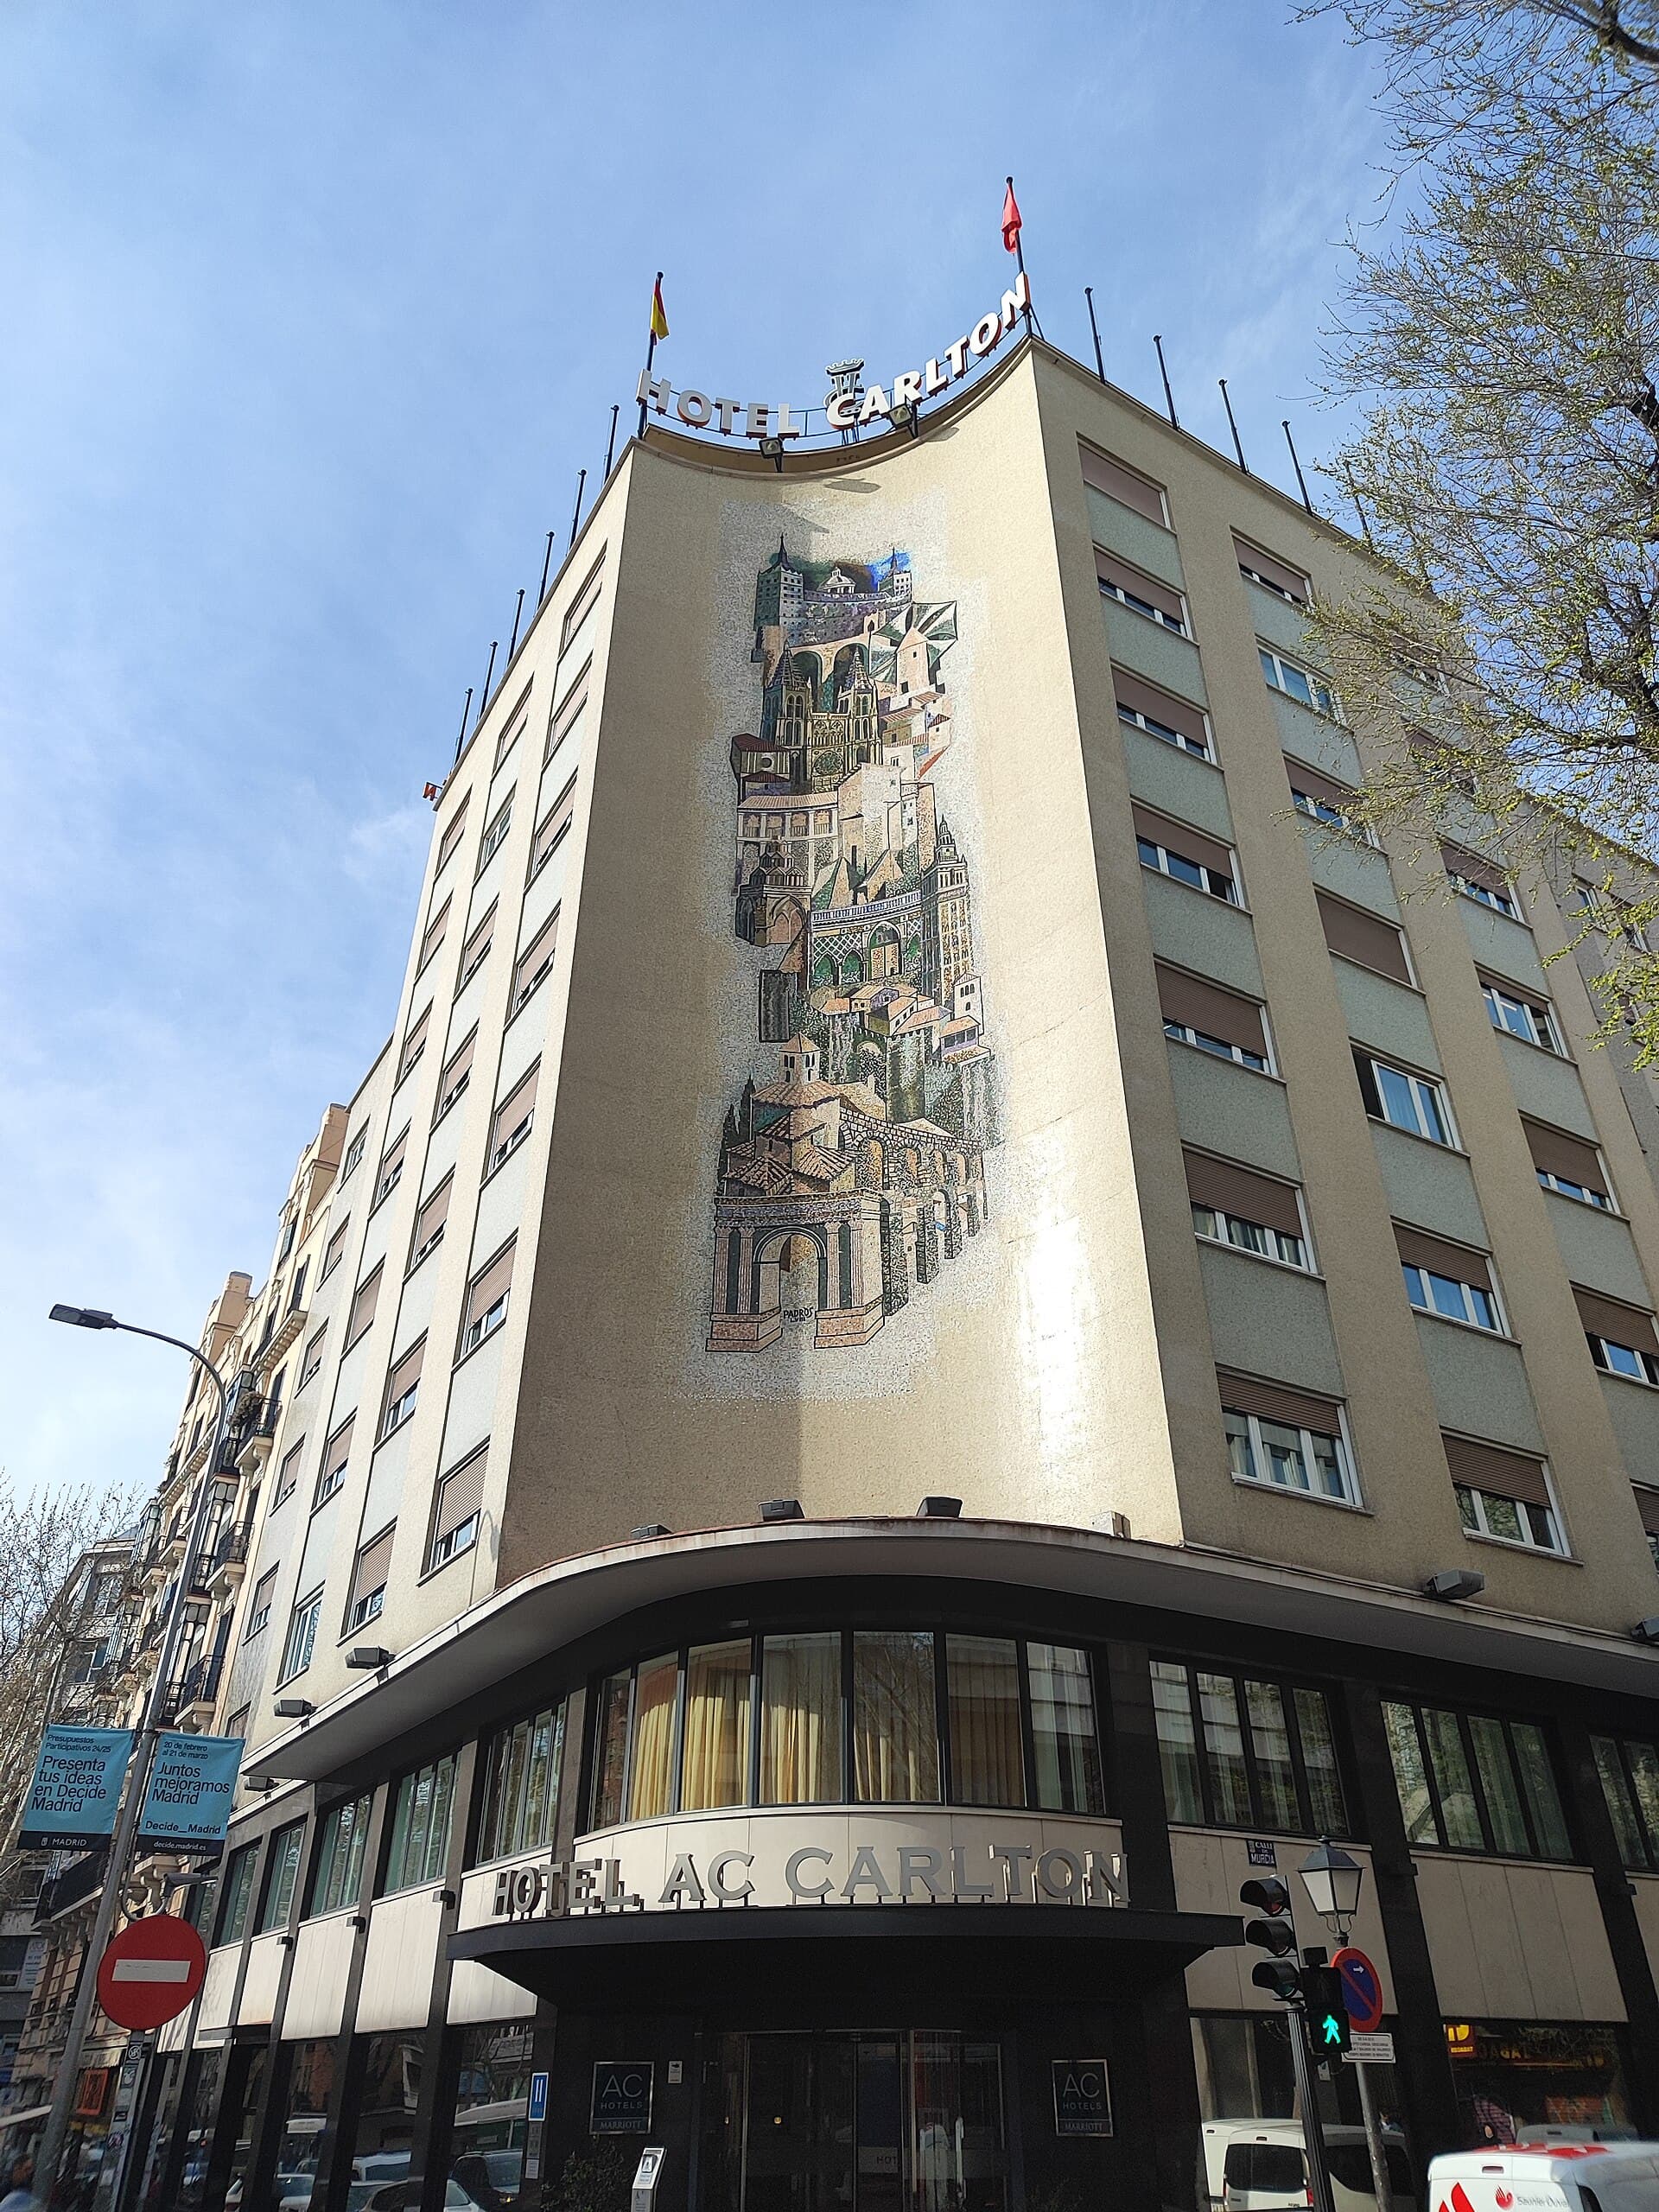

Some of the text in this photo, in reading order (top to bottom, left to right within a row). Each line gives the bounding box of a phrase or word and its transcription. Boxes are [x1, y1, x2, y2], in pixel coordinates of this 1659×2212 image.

[636, 271, 1031, 438] HOTEL CARLTON
[45, 1742, 91, 1751] Participativos
[48, 1734, 94, 1744] Presupuestos
[184, 1743, 207, 1751] febrero
[41, 1756, 105, 1771] Presenta
[157, 1762, 201, 1777] Juntos
[39, 1769, 102, 1785] tus ideas
[35, 1784, 106, 1799] en Decide
[154, 1777, 230, 1793] mejoramos
[31, 1796, 83, 1812] Madrid
[151, 1789, 200, 1805] Madrid
[52, 1837, 87, 1847] MADRID
[154, 1840, 207, 1851] decide.madrid.es
[493, 1845, 1130, 1917] HOTEL AC CARLTON
[601, 2074, 643, 2098] AC
[1063, 2073, 1100, 2098] AC
[1063, 2101, 1102, 2110] HOTELS
[600, 2121, 642, 2130] MARRIOTT
[1065, 2122, 1103, 2131] MARRIOTT
